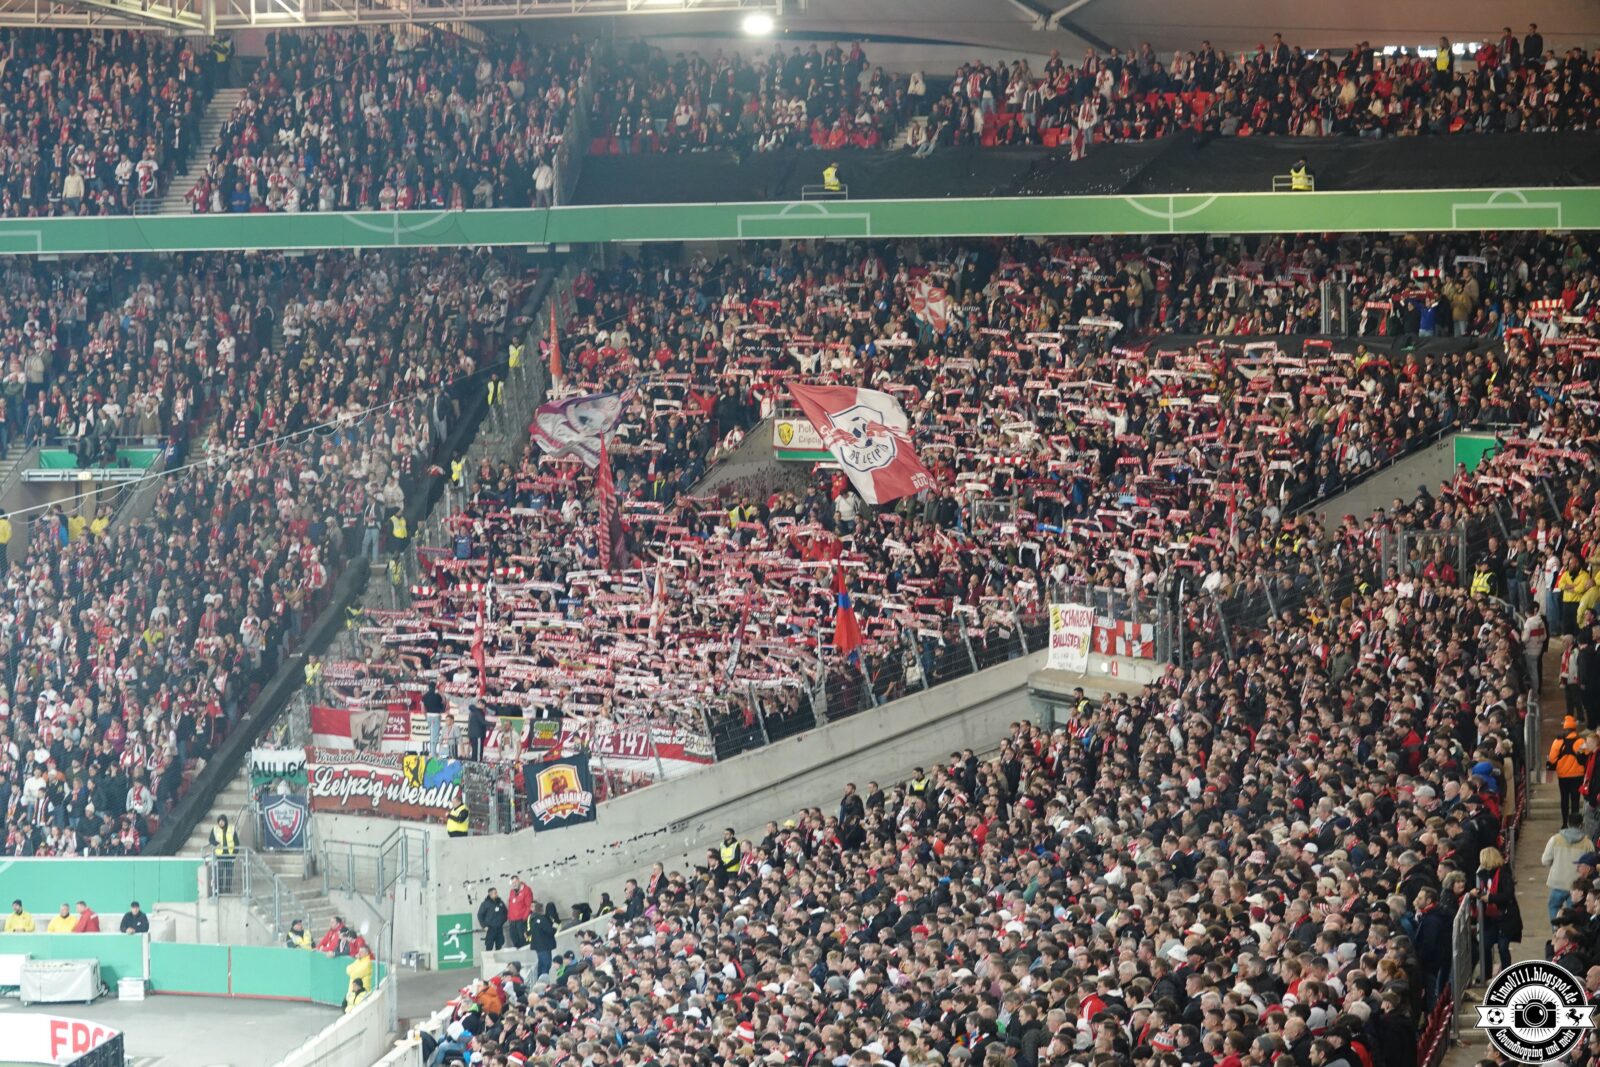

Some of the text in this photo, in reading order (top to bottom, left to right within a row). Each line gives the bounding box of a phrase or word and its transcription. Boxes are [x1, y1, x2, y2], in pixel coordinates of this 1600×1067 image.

[1060, 609, 1093, 628] SCHWABEN
[1052, 633, 1080, 649] BALLISTEN
[618, 731, 648, 755] 147
[252, 759, 308, 778] AULIGK
[312, 766, 386, 807] Leipzig
